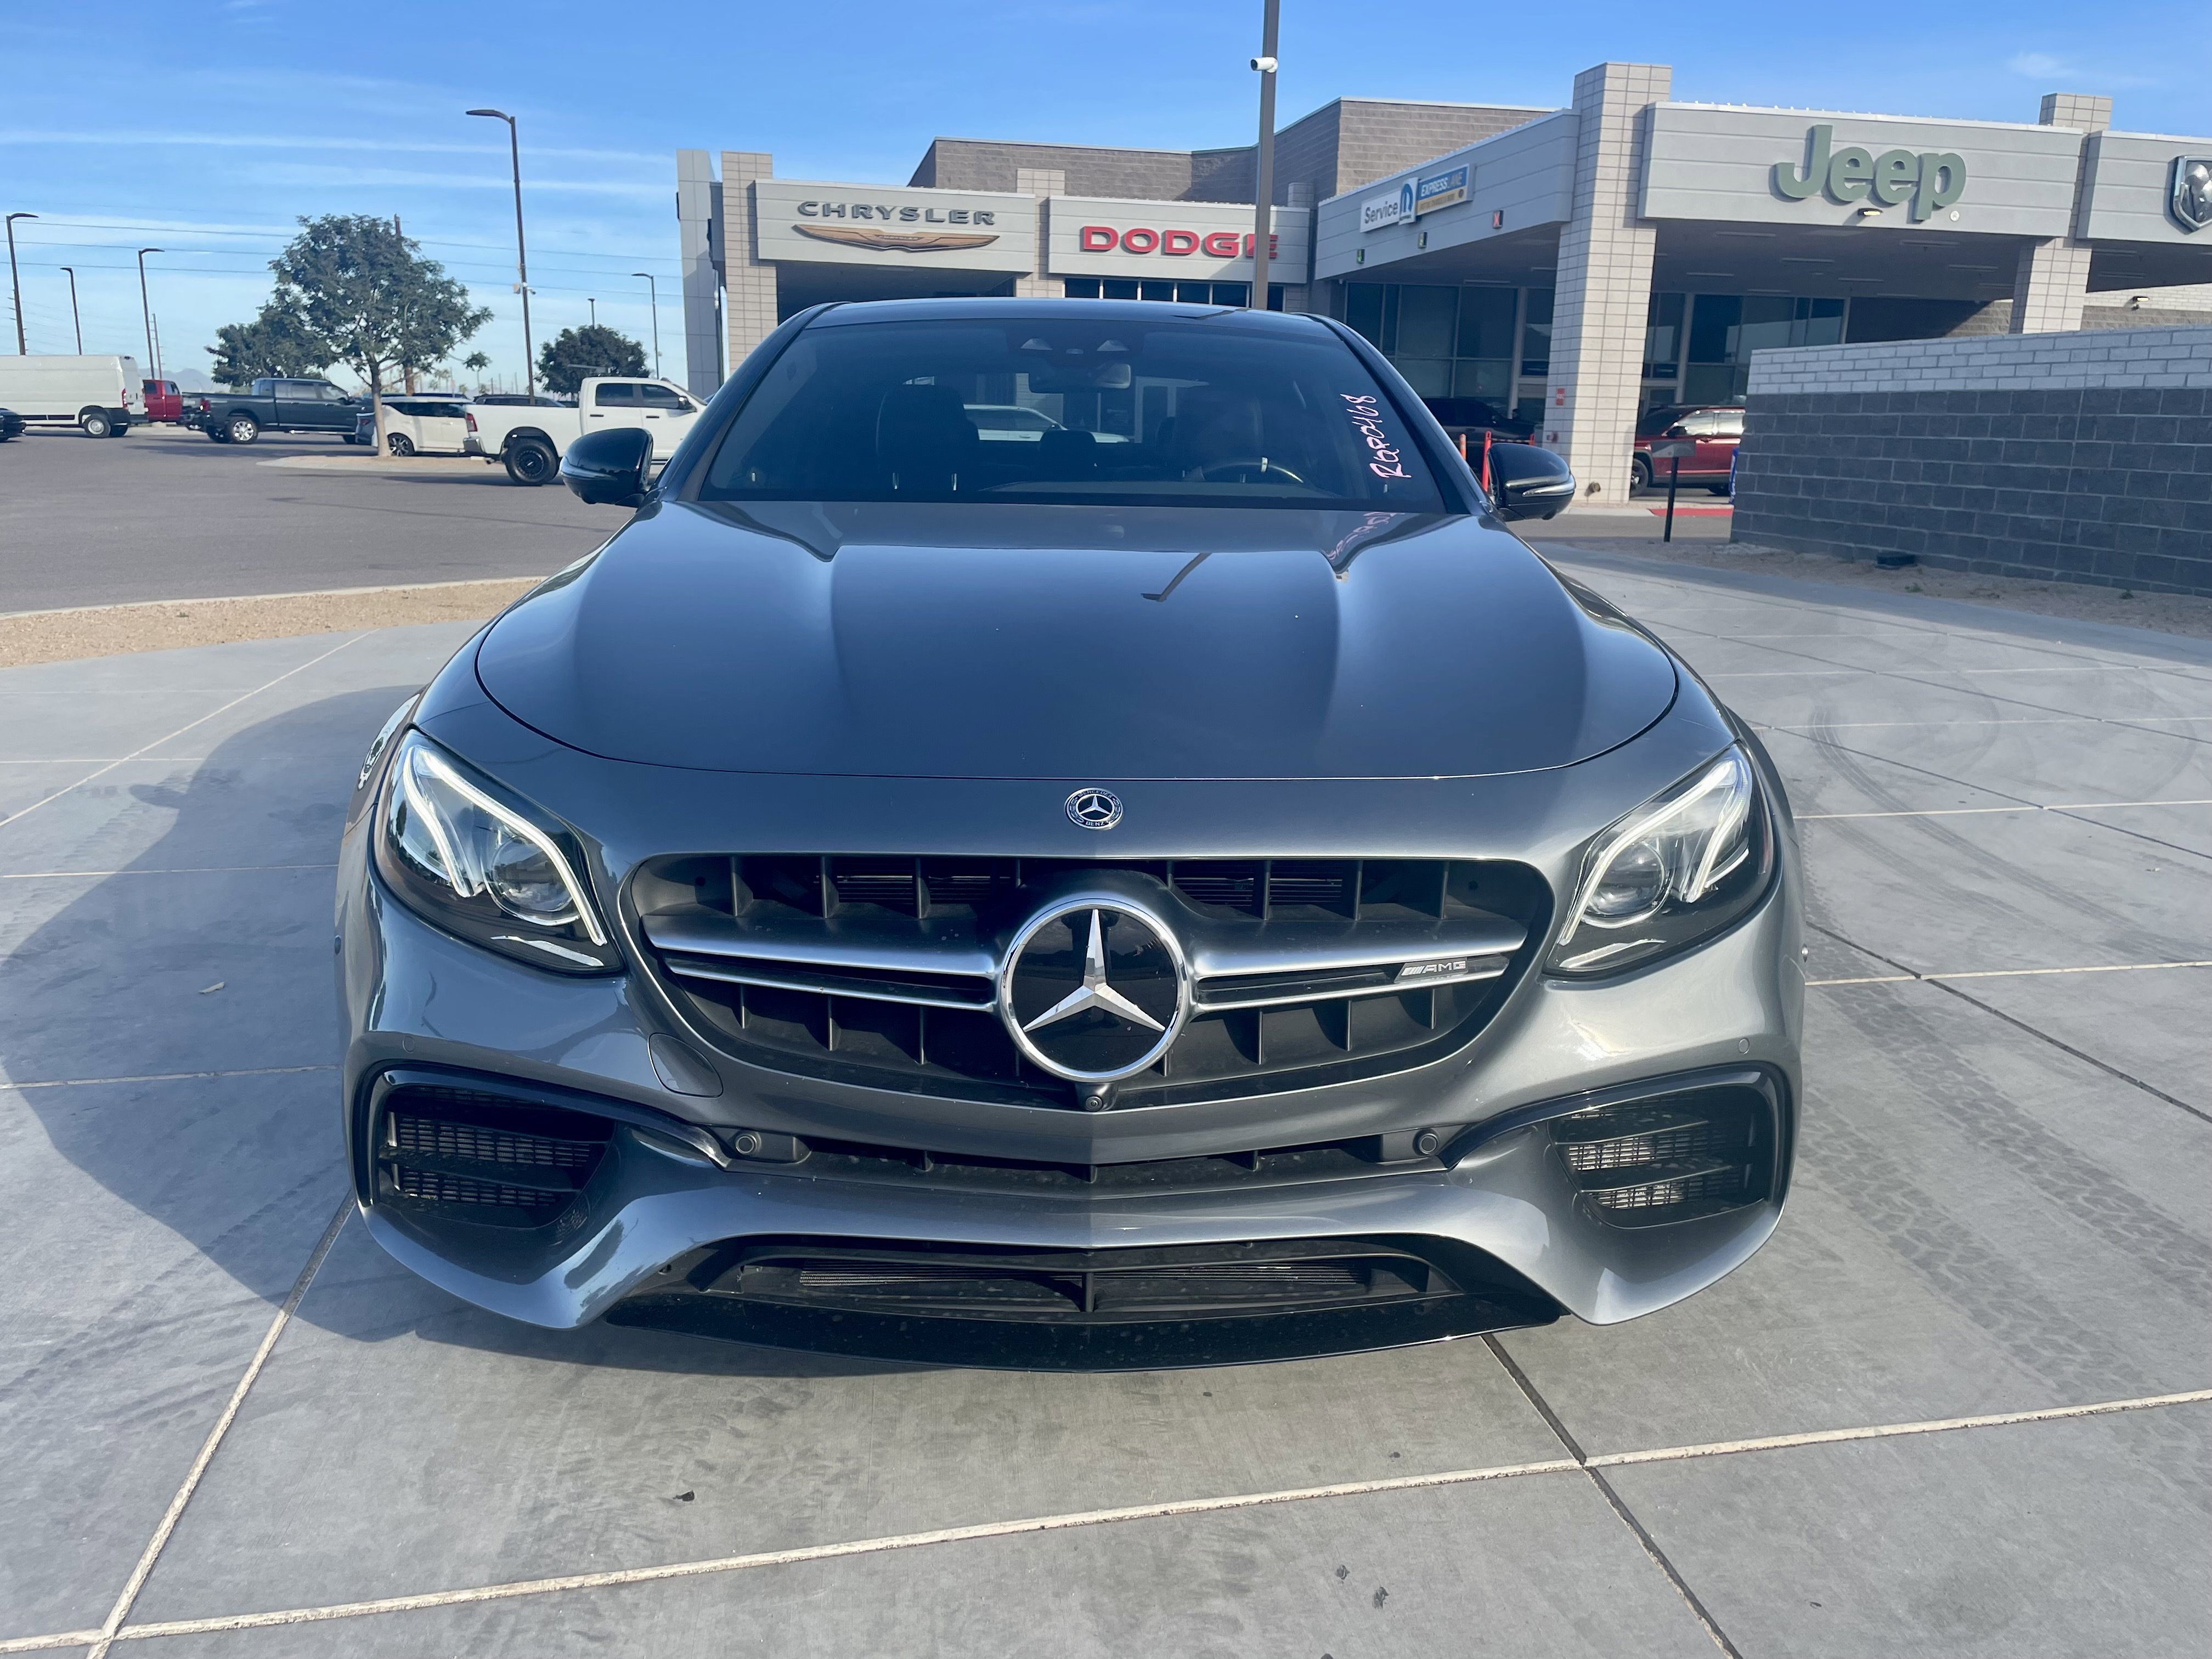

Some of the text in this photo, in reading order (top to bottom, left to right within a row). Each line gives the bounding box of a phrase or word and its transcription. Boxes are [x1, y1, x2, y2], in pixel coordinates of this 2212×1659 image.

[1771, 124, 1967, 221] Jeep
[1421, 177, 1448, 197] EXPRESS
[798, 201, 995, 225] CHRYSLER
[1364, 201, 1398, 224] Service
[1082, 225, 1278, 259] DODGE
[1077, 789, 1113, 798] MERCEDES
[1422, 961, 1466, 974] AMG
